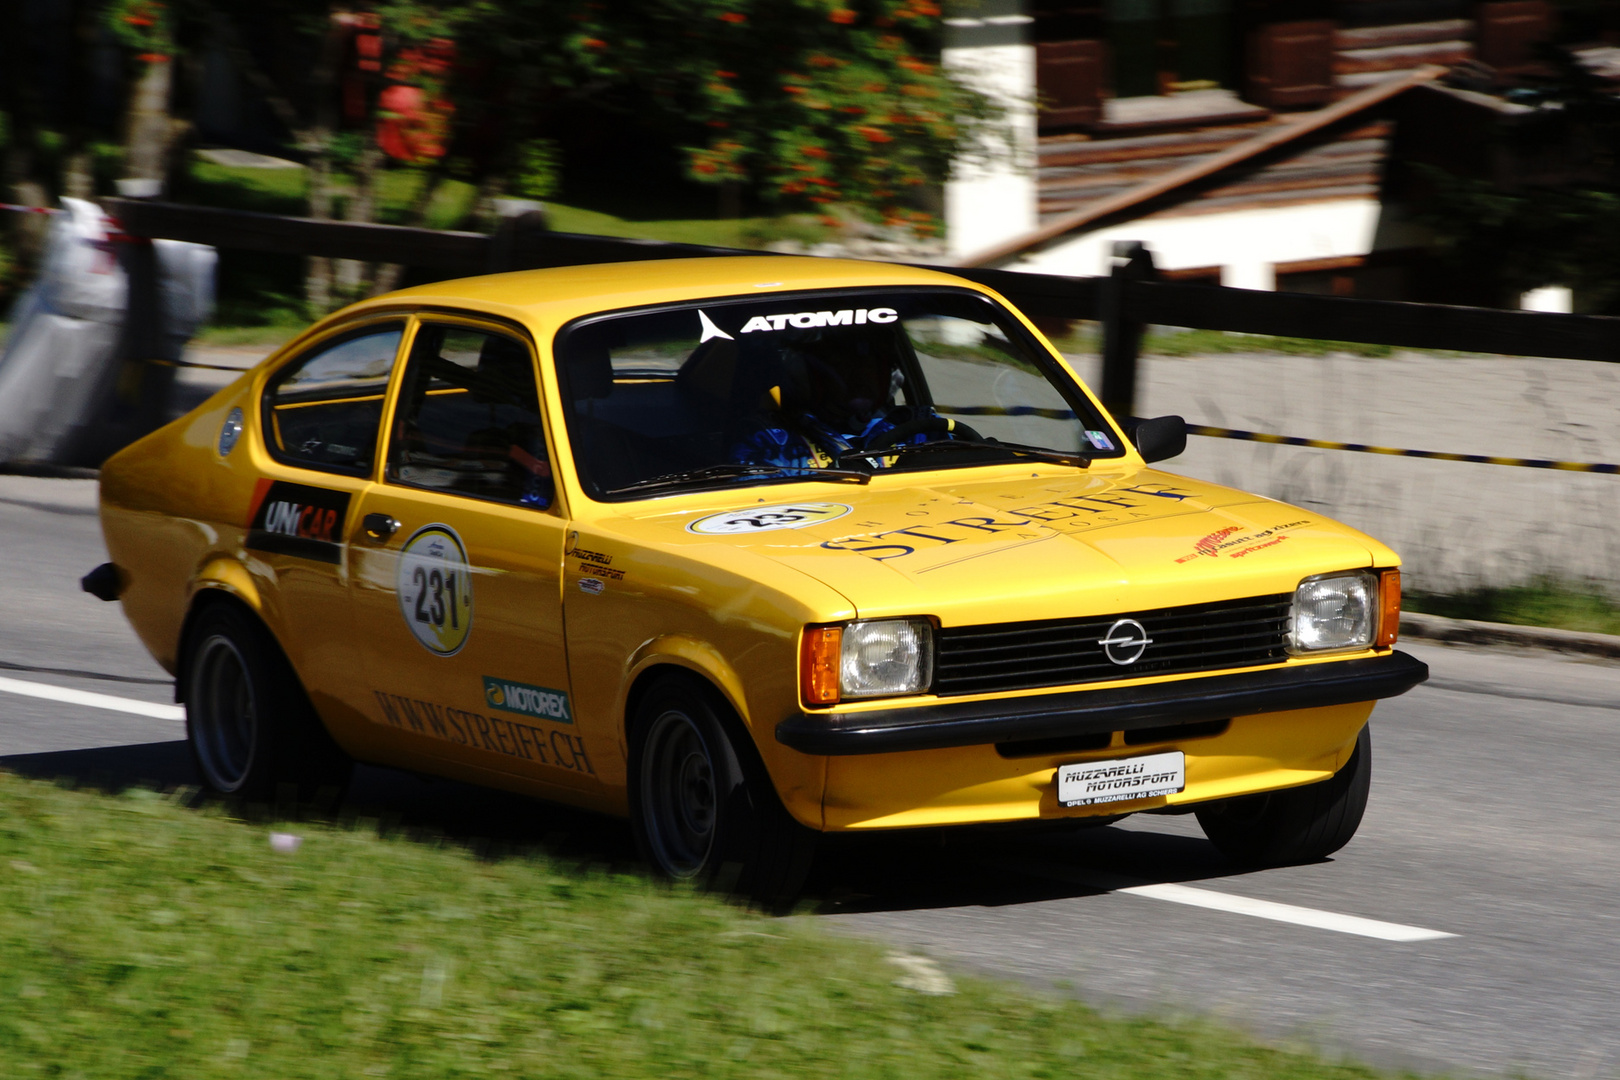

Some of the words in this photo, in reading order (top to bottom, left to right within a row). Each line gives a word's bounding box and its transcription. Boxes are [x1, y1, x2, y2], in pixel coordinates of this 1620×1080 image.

[740, 308, 898, 333] ATOMIC
[725, 508, 831, 527] 231
[820, 483, 1198, 562] STREIFF
[579, 562, 626, 581] MOTORSPORT
[413, 566, 459, 630] 231
[504, 684, 569, 719] MOTOREX
[1065, 763, 1144, 783] MUZZARELLI
[1086, 771, 1178, 793] MOTORSPORT
[1094, 793, 1135, 804] MUZZARELLI
[1136, 791, 1147, 799] AG
